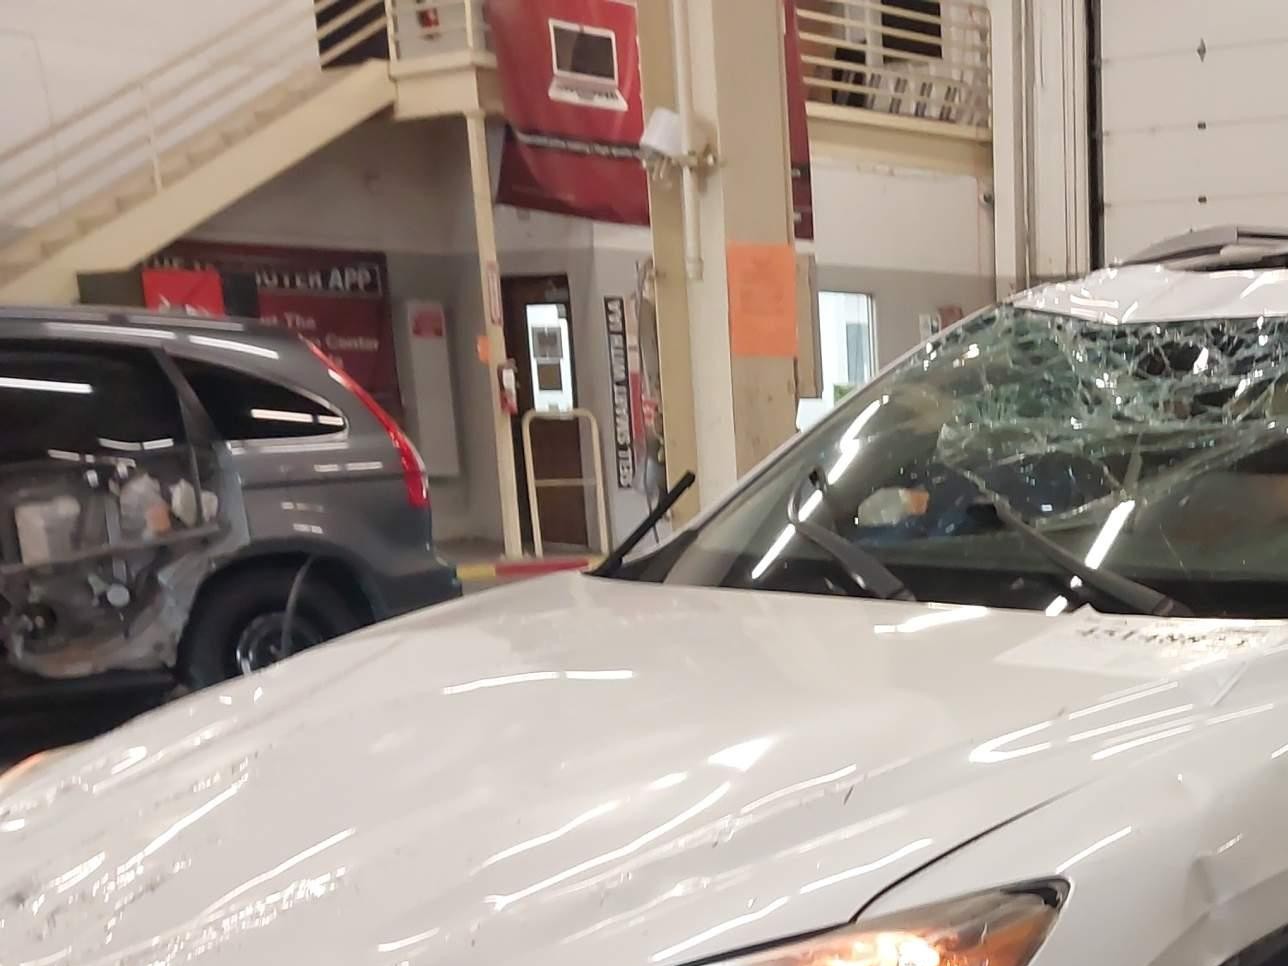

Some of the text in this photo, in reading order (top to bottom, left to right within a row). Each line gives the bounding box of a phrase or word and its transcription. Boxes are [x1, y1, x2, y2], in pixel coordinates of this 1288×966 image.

[328, 266, 372, 291] APP
[326, 333, 379, 351] Center
[607, 300, 633, 488] SELL SMART WITH IAA
